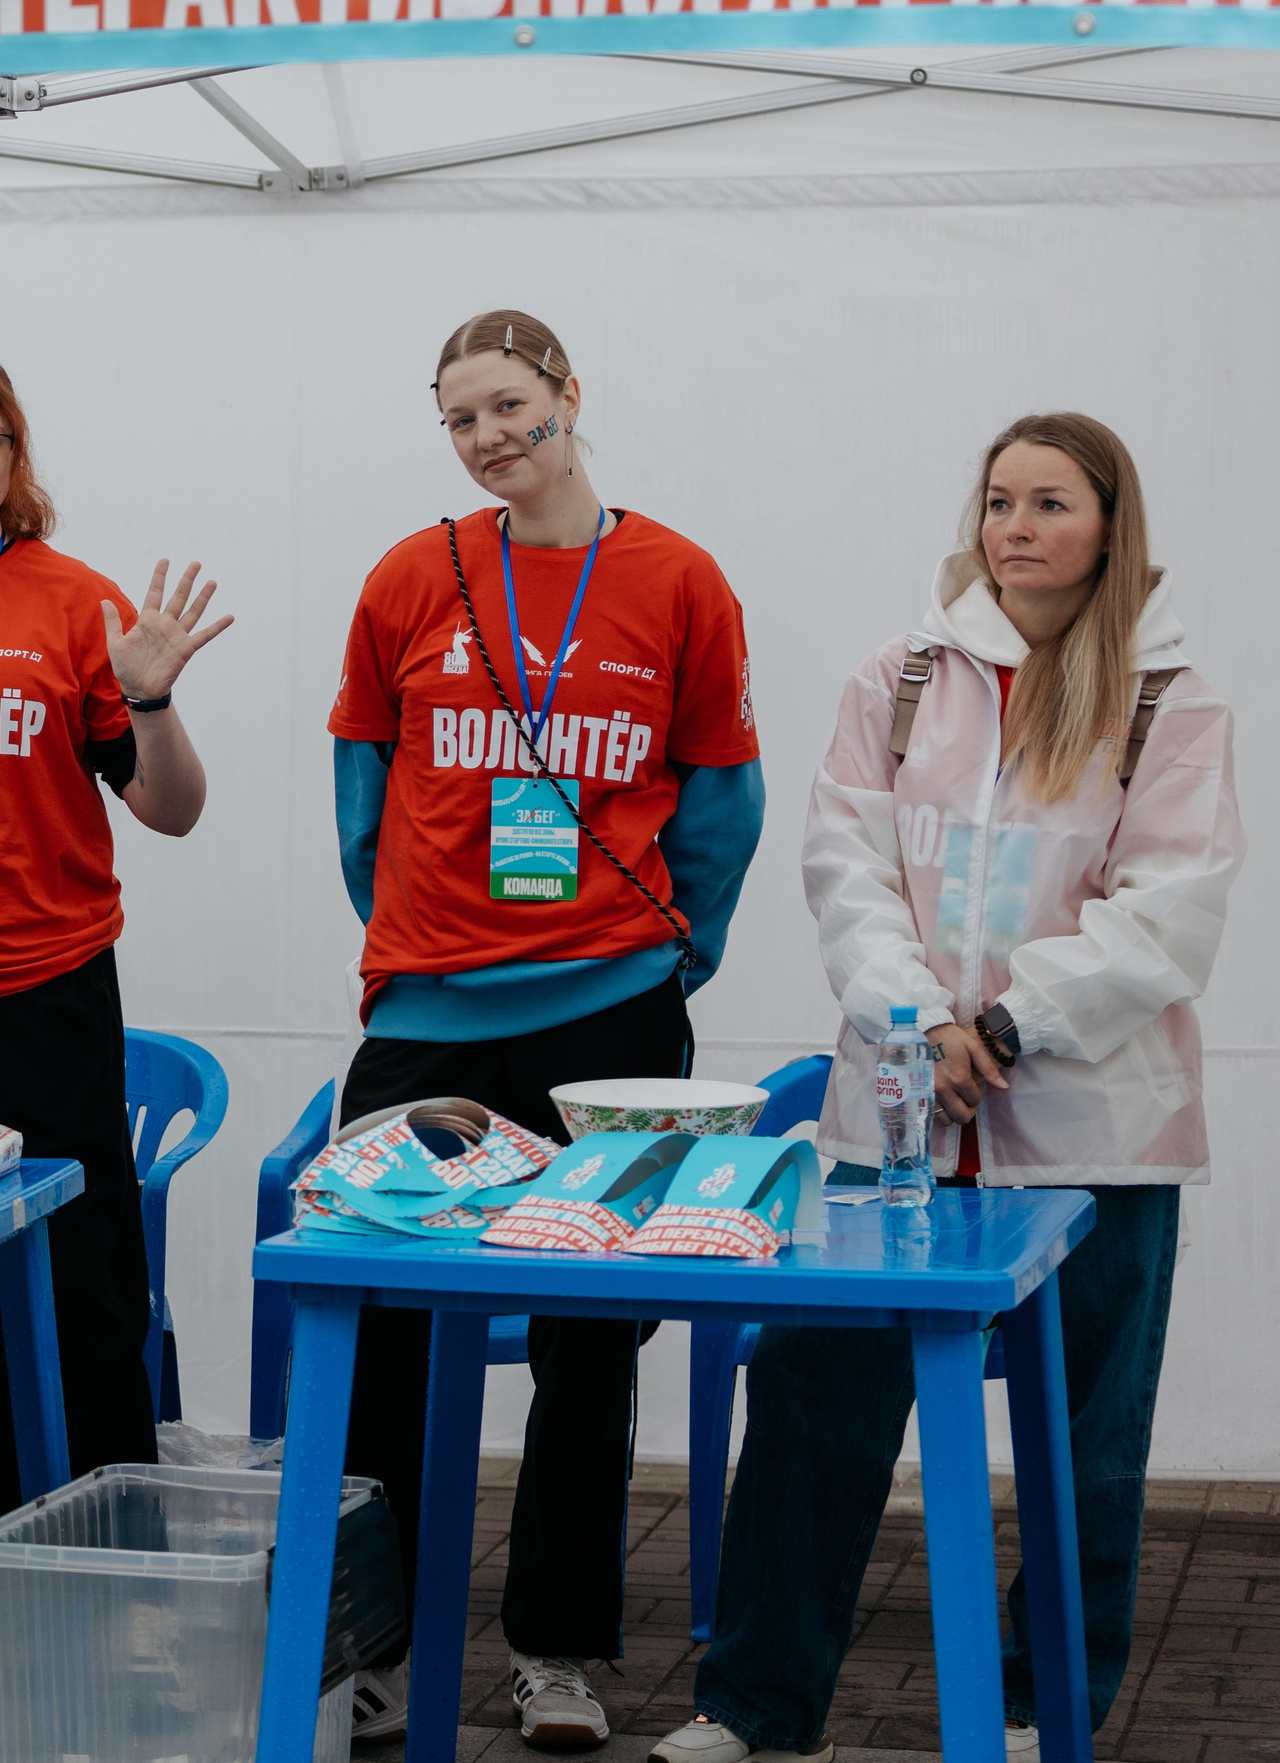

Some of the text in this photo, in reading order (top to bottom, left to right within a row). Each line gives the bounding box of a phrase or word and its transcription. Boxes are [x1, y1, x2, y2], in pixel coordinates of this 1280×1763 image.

[599, 660, 641, 677] СПОРТ
[432, 708, 652, 782] ВОЛОНТЁР
[504, 877, 563, 898] КОМАНДА
[672, 1240, 703, 1253] БЕГ
